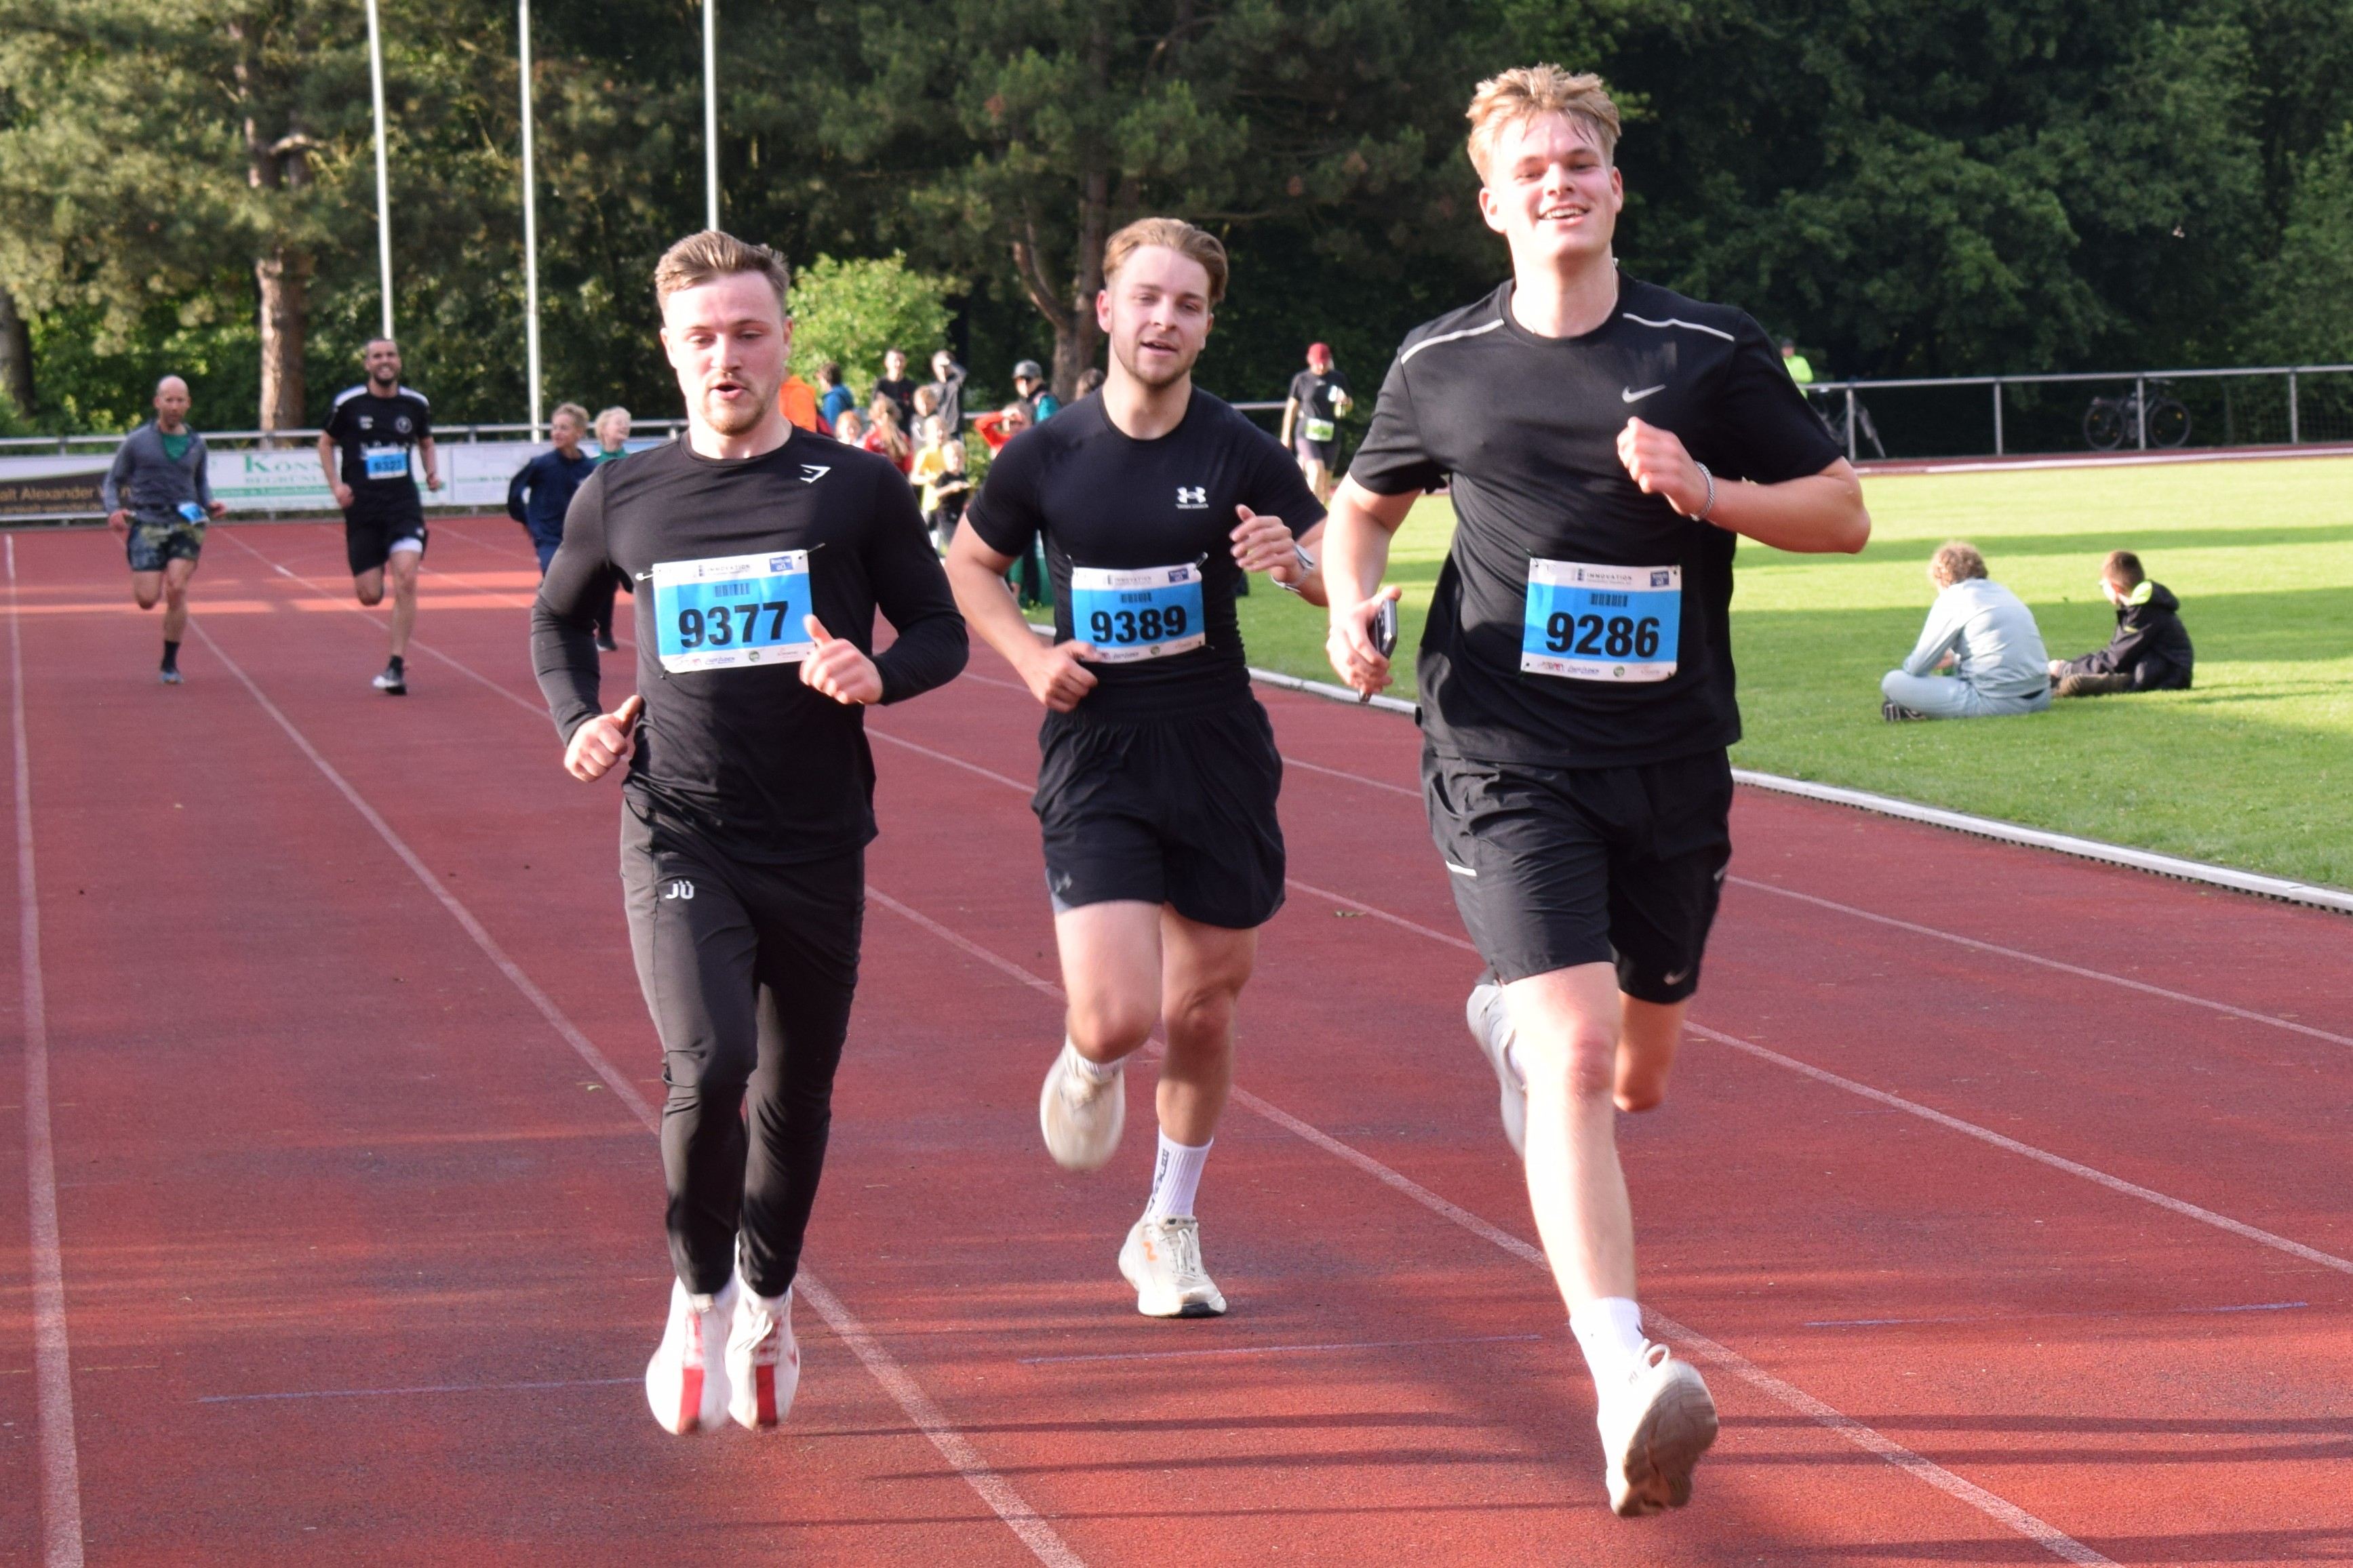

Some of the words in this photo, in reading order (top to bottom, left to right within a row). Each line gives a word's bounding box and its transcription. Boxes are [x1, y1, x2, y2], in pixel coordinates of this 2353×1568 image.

[21, 486, 94, 500] Alexander
[678, 601, 789, 649] 9377
[1090, 605, 1186, 643] 9389
[1545, 611, 1660, 658] 9286
